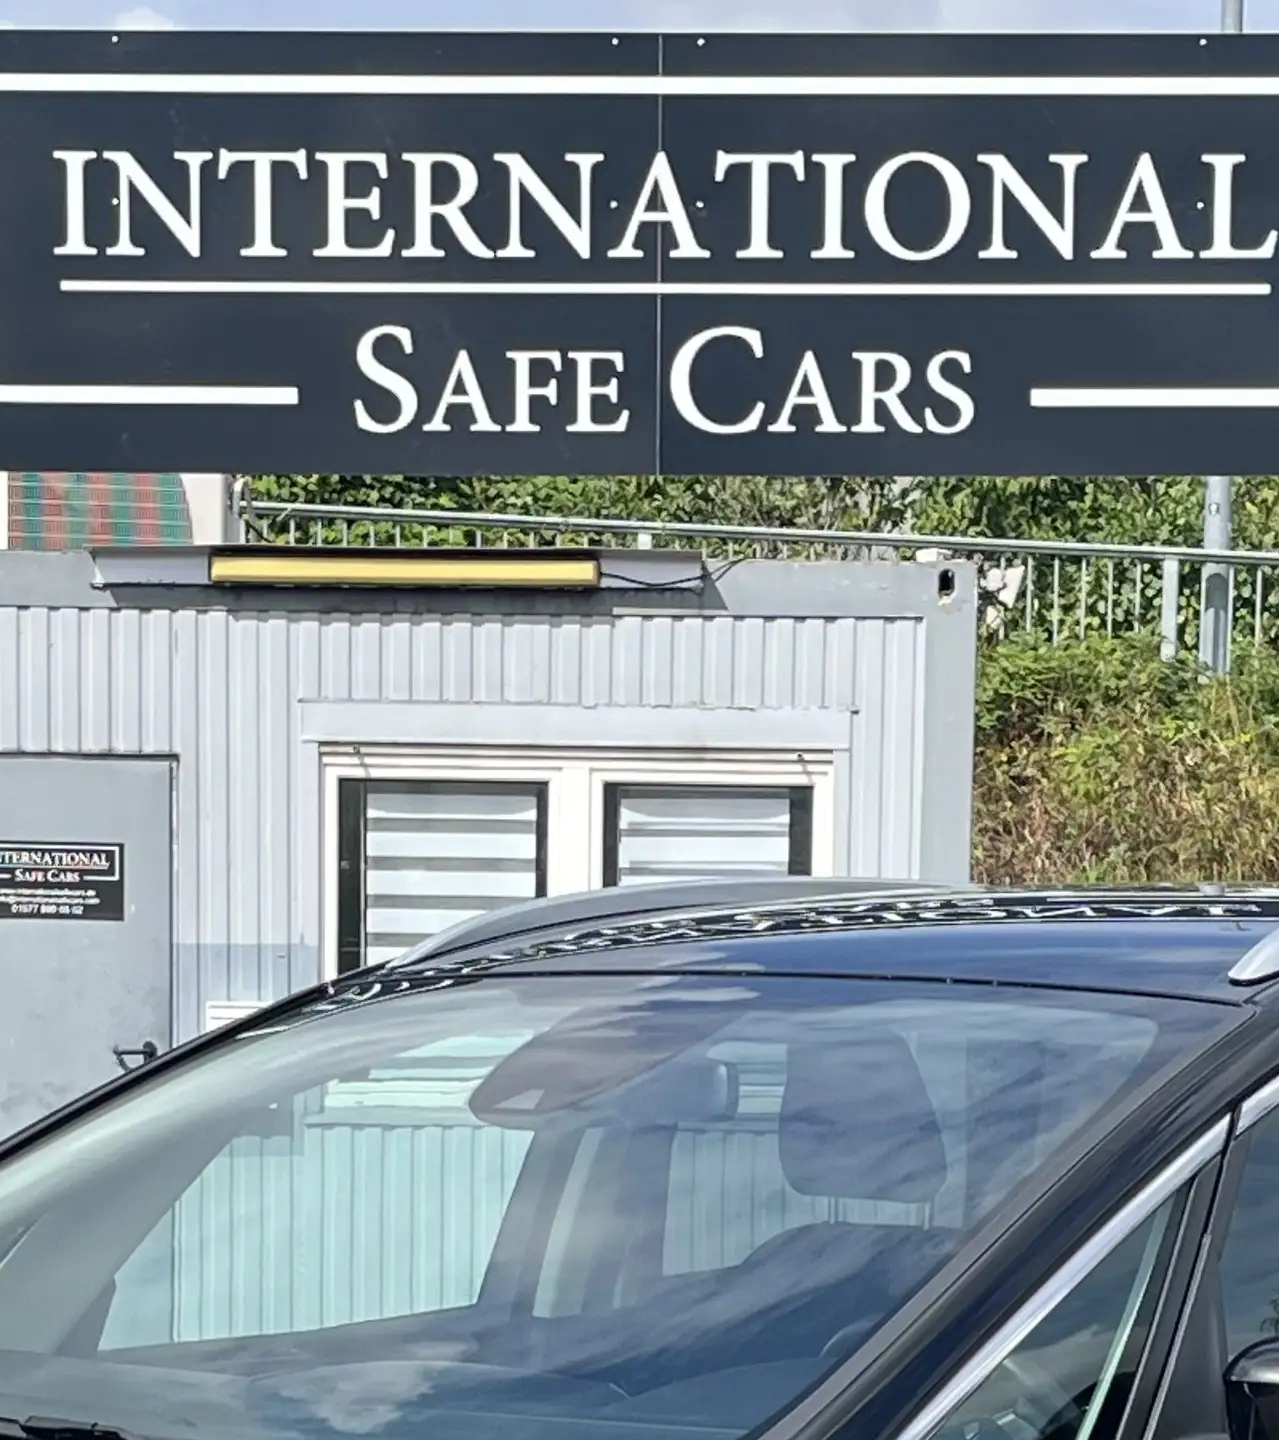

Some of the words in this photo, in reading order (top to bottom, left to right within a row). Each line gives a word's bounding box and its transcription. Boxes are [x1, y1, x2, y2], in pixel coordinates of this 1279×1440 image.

[52, 149, 1279, 261] INTERNATIONAL
[353, 325, 629, 434] SAFE
[669, 326, 974, 435] CARS
[14, 868, 46, 882] SAFE
[47, 869, 81, 883] CARS
